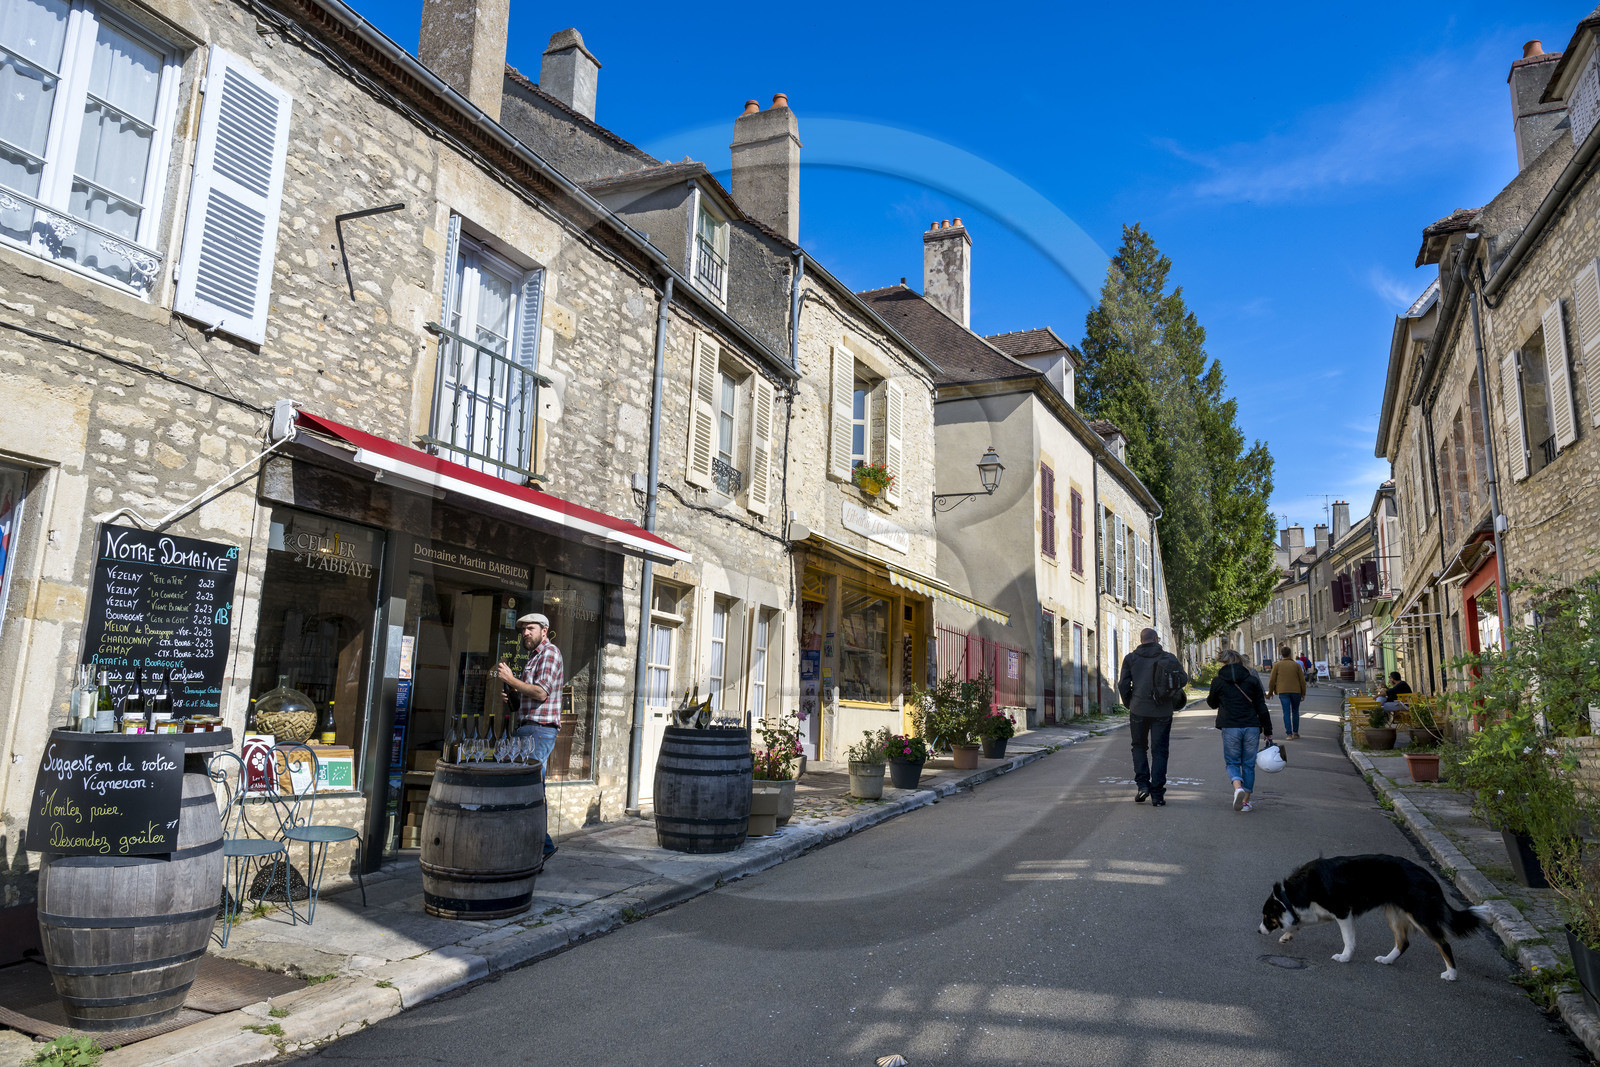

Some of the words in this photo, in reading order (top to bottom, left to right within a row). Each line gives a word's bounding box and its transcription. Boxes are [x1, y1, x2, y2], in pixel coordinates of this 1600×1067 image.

[105, 532, 156, 562] NOTRE
[297, 532, 356, 559] CELLIER
[306, 552, 373, 579] L'ABBAYE
[414, 543, 457, 563] Domaine
[459, 554, 487, 570] Martin
[489, 561, 529, 580] BARBIEUX
[106, 565, 143, 582] VEZELAY
[198, 578, 215, 588] 2023
[106, 579, 140, 597] VEZELAY
[196, 591, 213, 601] 2023
[106, 597, 139, 610] VEZELAY
[194, 604, 213, 613] 2023
[104, 620, 131, 632] MELON
[135, 625, 142, 634] de
[194, 627, 212, 637] 2023
[193, 616, 212, 625] 2023
[99, 644, 133, 656] GAMAY
[101, 634, 153, 647] CHARDONNAY
[91, 654, 128, 666] RATAFIA
[145, 658, 184, 668] BOURGOGNE
[125, 669, 148, 680] ausi
[118, 755, 134, 772] de
[142, 753, 177, 772] votre
[41, 788, 82, 823] Montez
[90, 804, 124, 822] prier.
